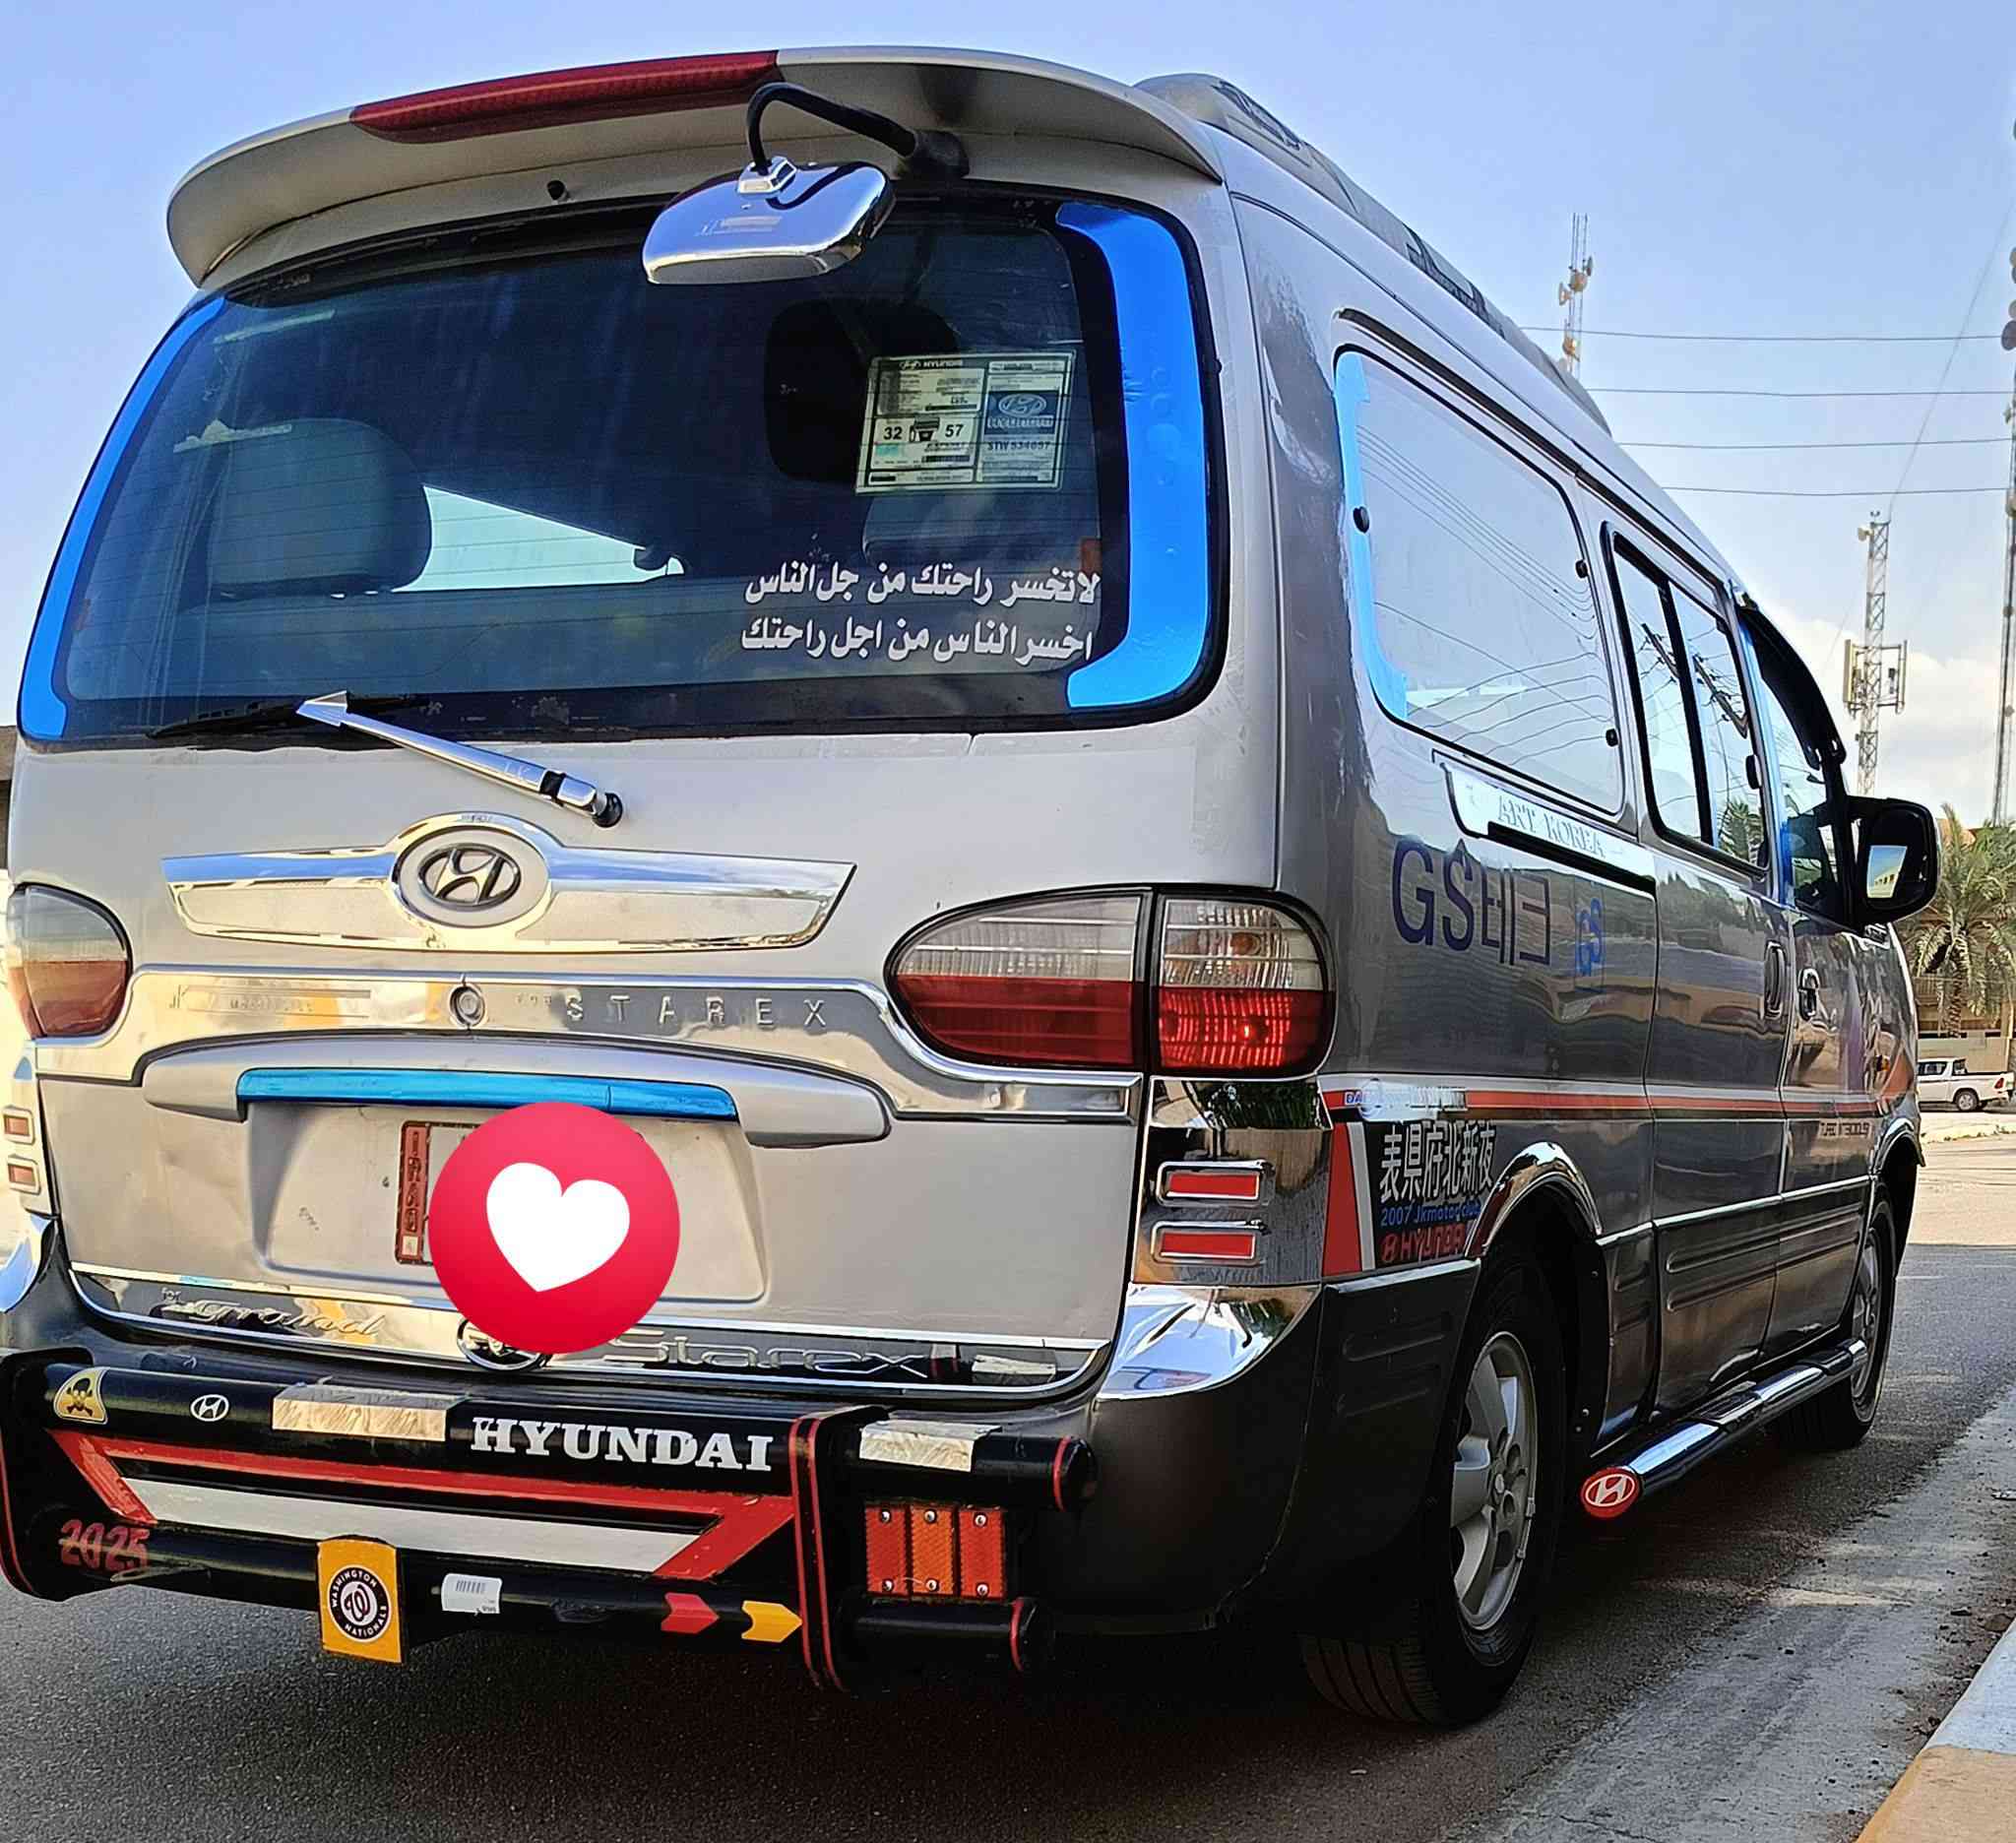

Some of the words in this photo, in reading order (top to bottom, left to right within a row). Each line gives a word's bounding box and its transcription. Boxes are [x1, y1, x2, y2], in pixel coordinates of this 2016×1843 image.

[883, 425, 904, 441] 32
[944, 423, 965, 439] 57
[745, 560, 816, 604] الناس
[867, 561, 906, 604] من
[912, 563, 993, 605] راحتك
[741, 617, 826, 658] راحتك
[831, 616, 883, 659] اجل
[888, 617, 929, 662] من
[933, 619, 1018, 662] الناس
[1015, 624, 1093, 667] اخسر
[1498, 795, 1537, 833] ART
[565, 992, 828, 1028] STAREX
[1401, 1223, 1466, 1261] HYUNDA
[471, 1417, 774, 1472] HYUNDAI
[60, 1519, 151, 1570] 2025
[331, 1569, 378, 1609] WASHINGTON
